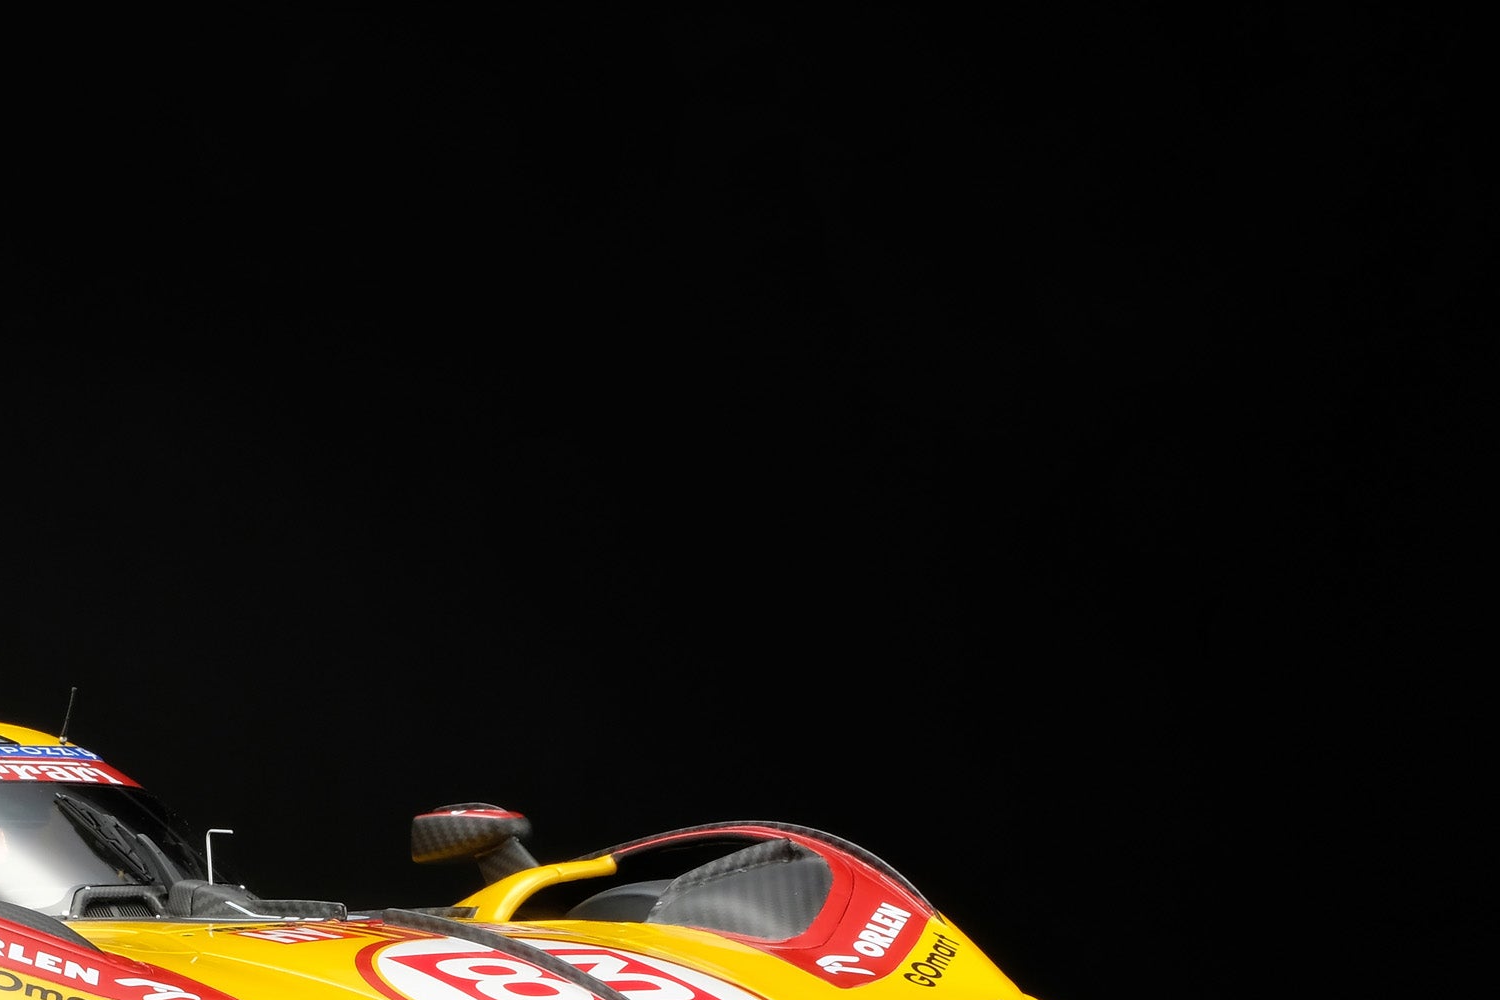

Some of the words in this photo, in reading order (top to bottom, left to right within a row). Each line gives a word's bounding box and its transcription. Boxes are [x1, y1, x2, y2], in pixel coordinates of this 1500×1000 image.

[0, 746, 79, 757] POZZI
[853, 902, 912, 957] ORLEN
[904, 932, 960, 987] GOmart
